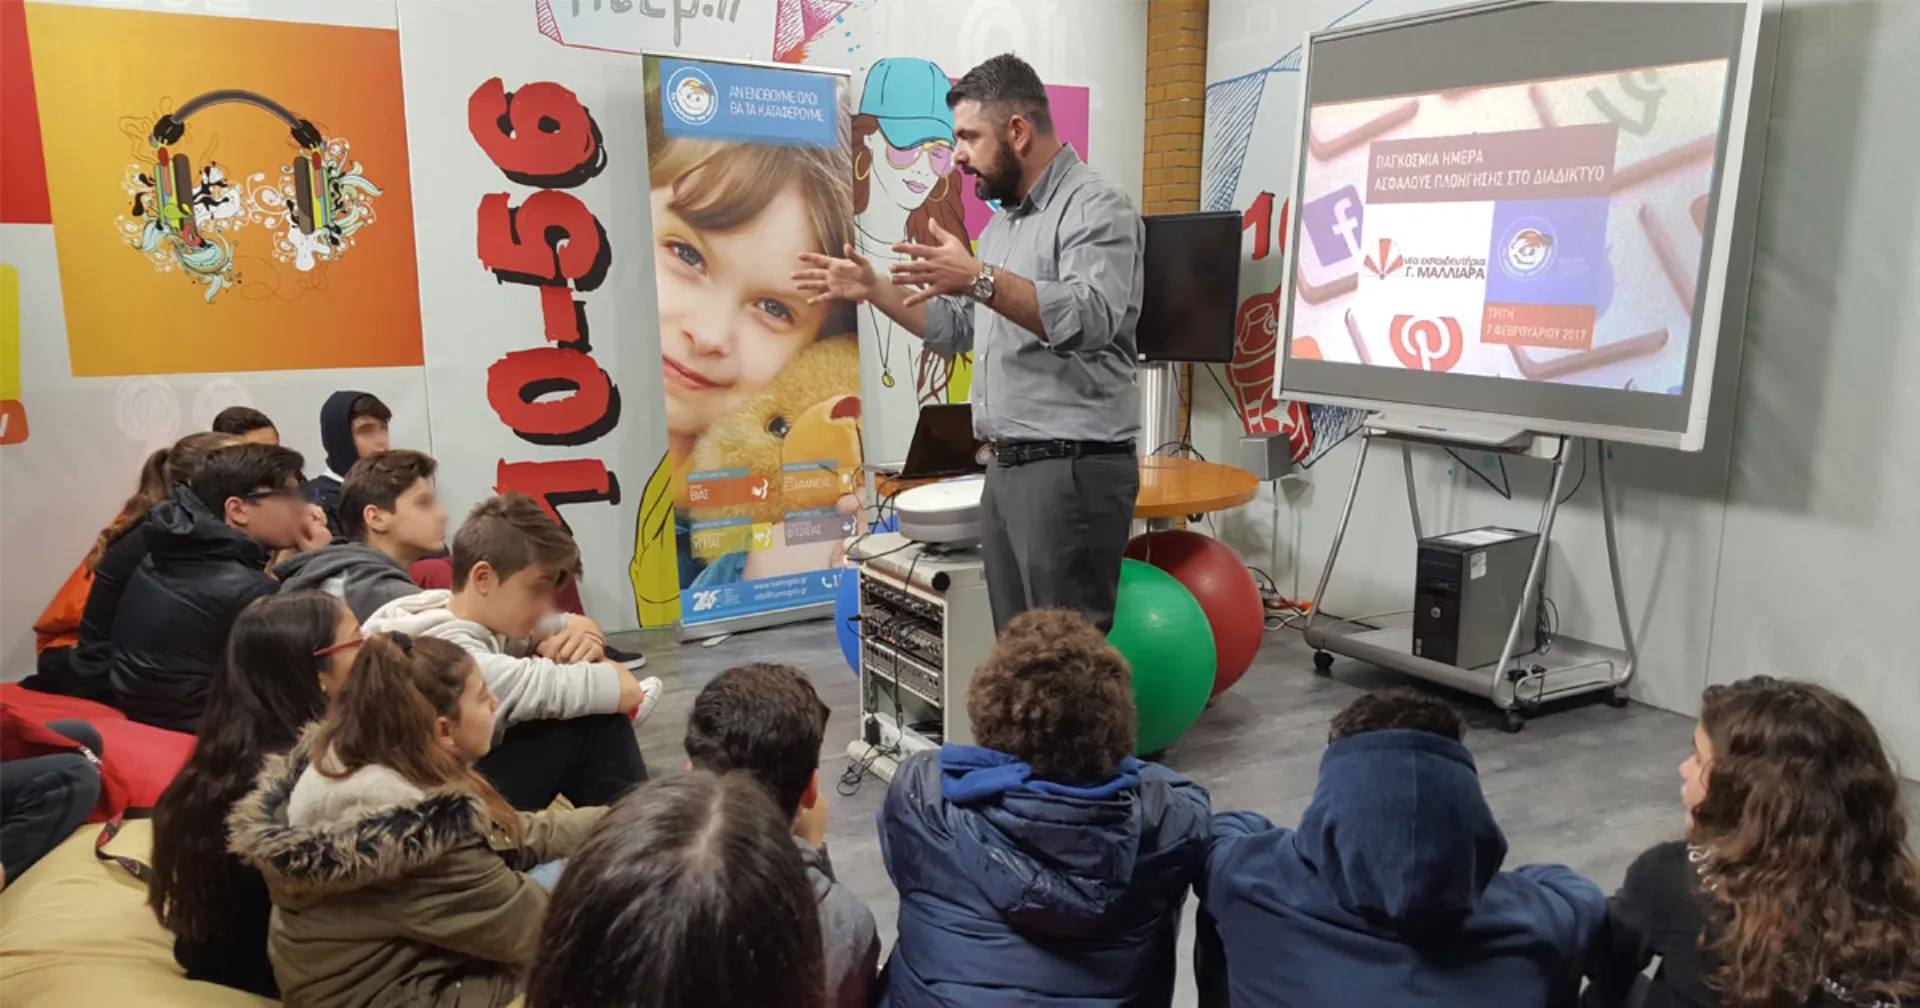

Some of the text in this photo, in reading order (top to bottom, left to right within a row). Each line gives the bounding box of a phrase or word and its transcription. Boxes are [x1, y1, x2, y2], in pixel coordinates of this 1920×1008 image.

[729, 85, 744, 99] ΑΝ
[729, 102, 745, 116] ΘΑ
[746, 103, 758, 117] ΤΑ
[1375, 149, 1484, 169] ΠΑΓΚΟΣΜΙΑ ΗΜΕΡΑ
[1374, 165, 1605, 191] ΑΣΦΑΛΟΥΣ ΠΛΟΗΓΗΣΗΣ ΣΤΟ ΔΙΑΔΙΚΤΥΟ
[1417, 266, 1486, 280] ΜΑΛΛΙΑΡΑ
[1488, 307, 1515, 321] ΤΡΙΤΗ
[1494, 324, 1562, 340] ΦΕΒΡΟΥΑΡΙΟΥ
[1562, 327, 1588, 342] 2017
